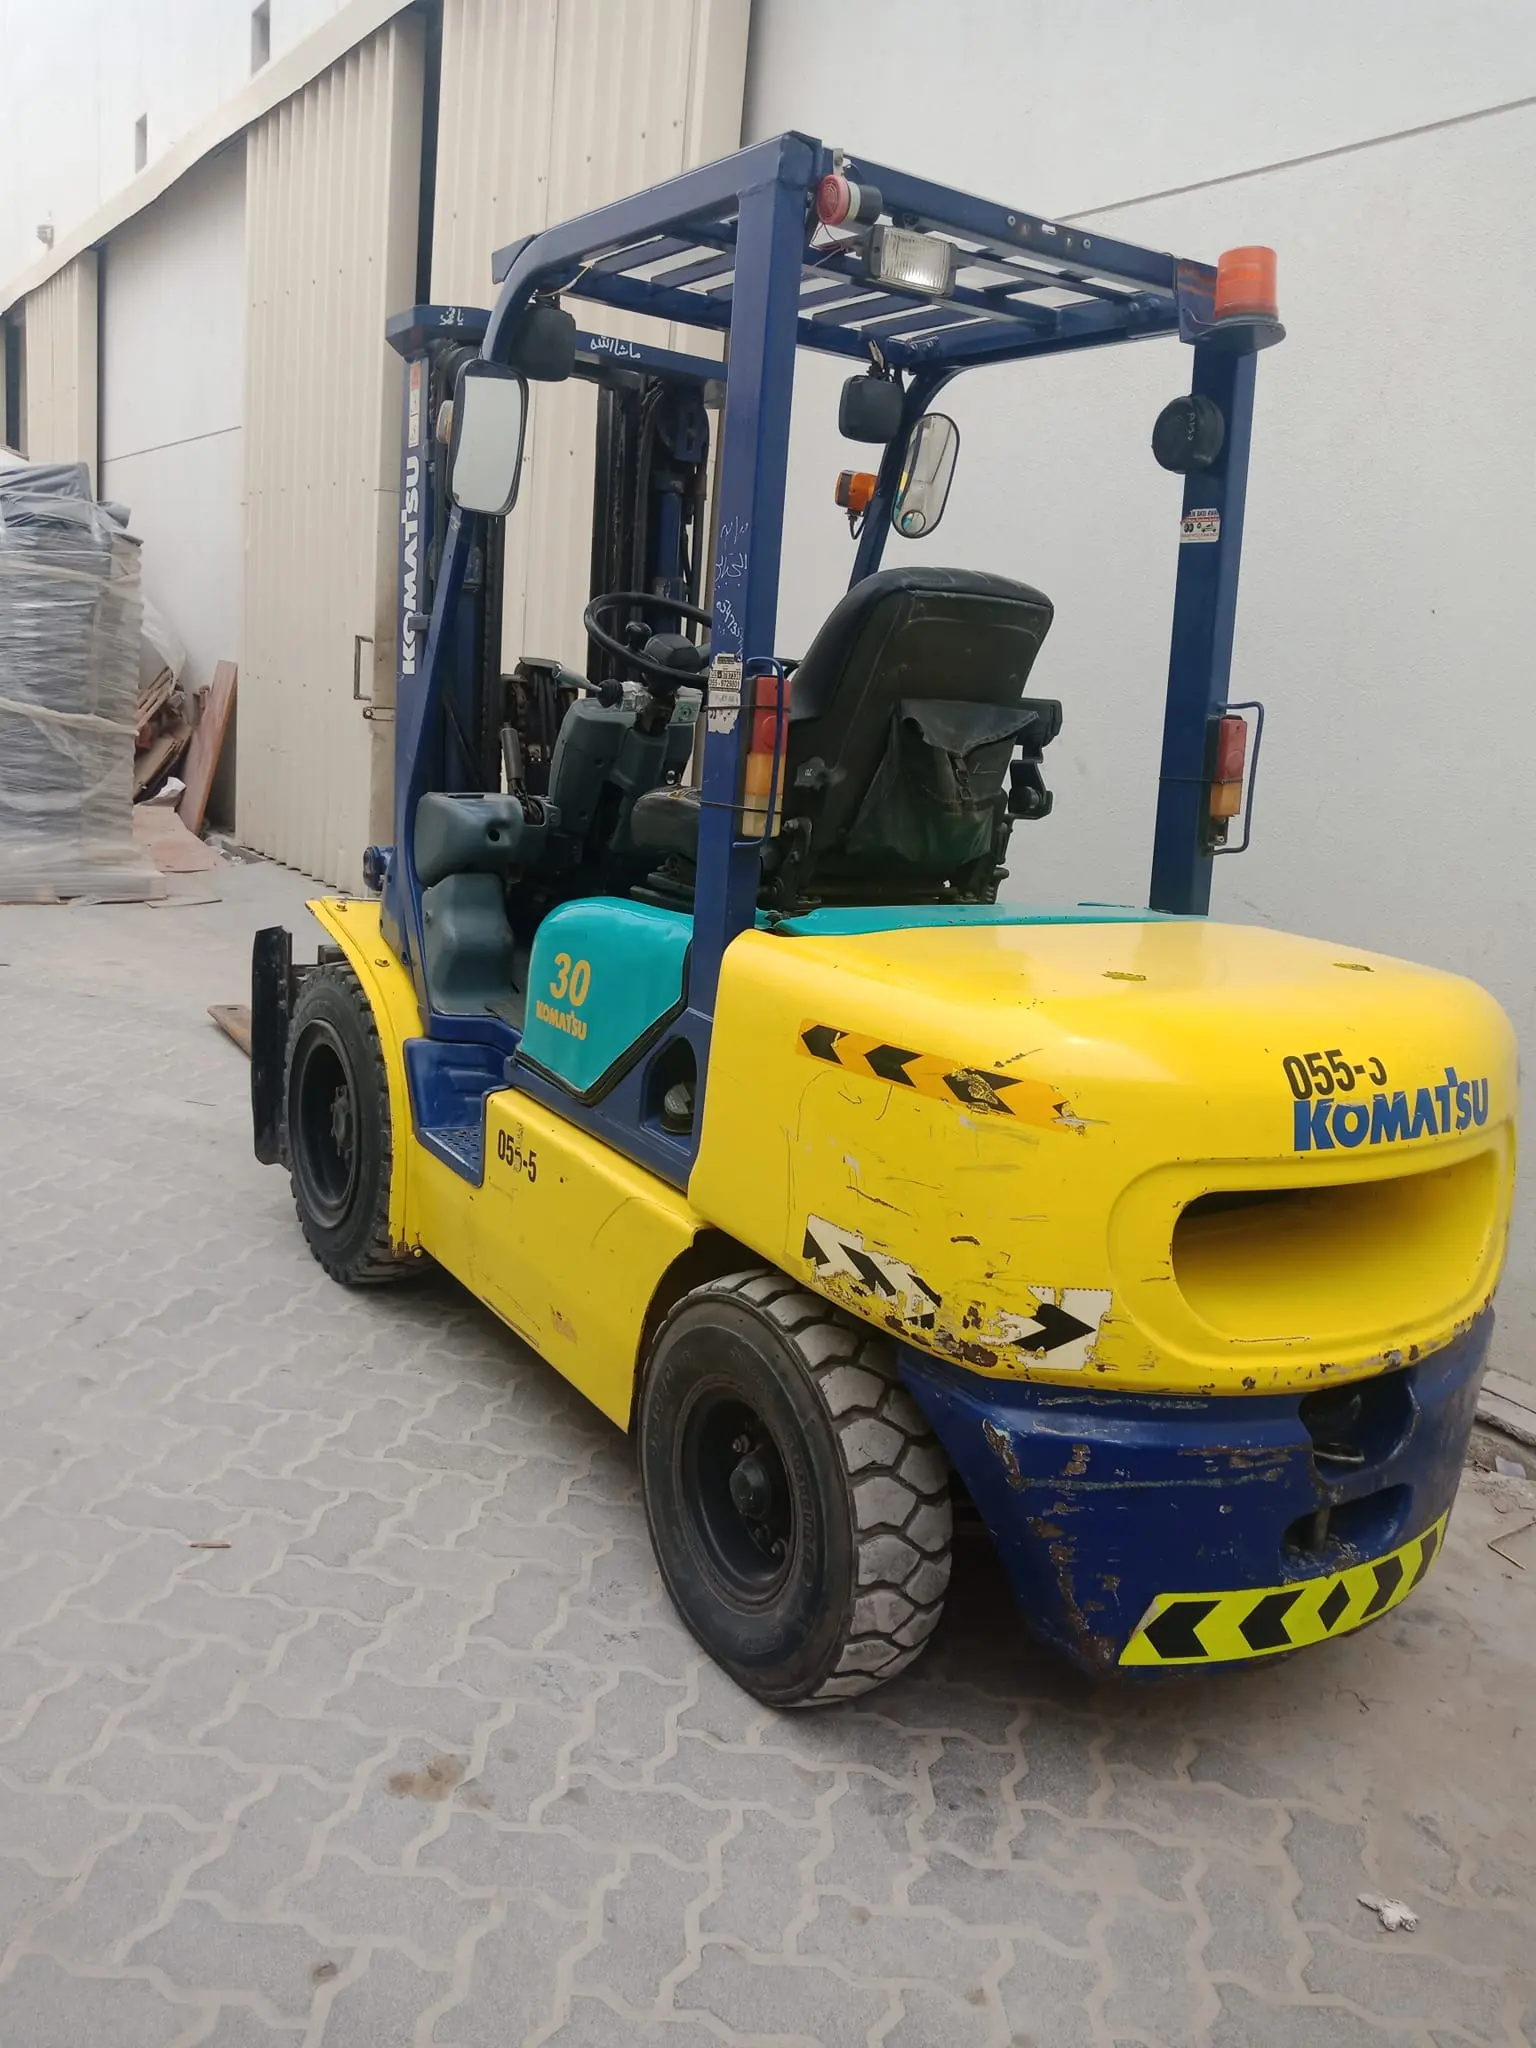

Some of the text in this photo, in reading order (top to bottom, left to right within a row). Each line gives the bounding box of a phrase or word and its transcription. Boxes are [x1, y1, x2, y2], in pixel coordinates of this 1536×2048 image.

[402, 455, 420, 675] KOMATSU
[550, 953, 591, 1006] 30
[536, 1000, 587, 1041] KOMATSU
[1294, 1067, 1489, 1151] KOMATSU
